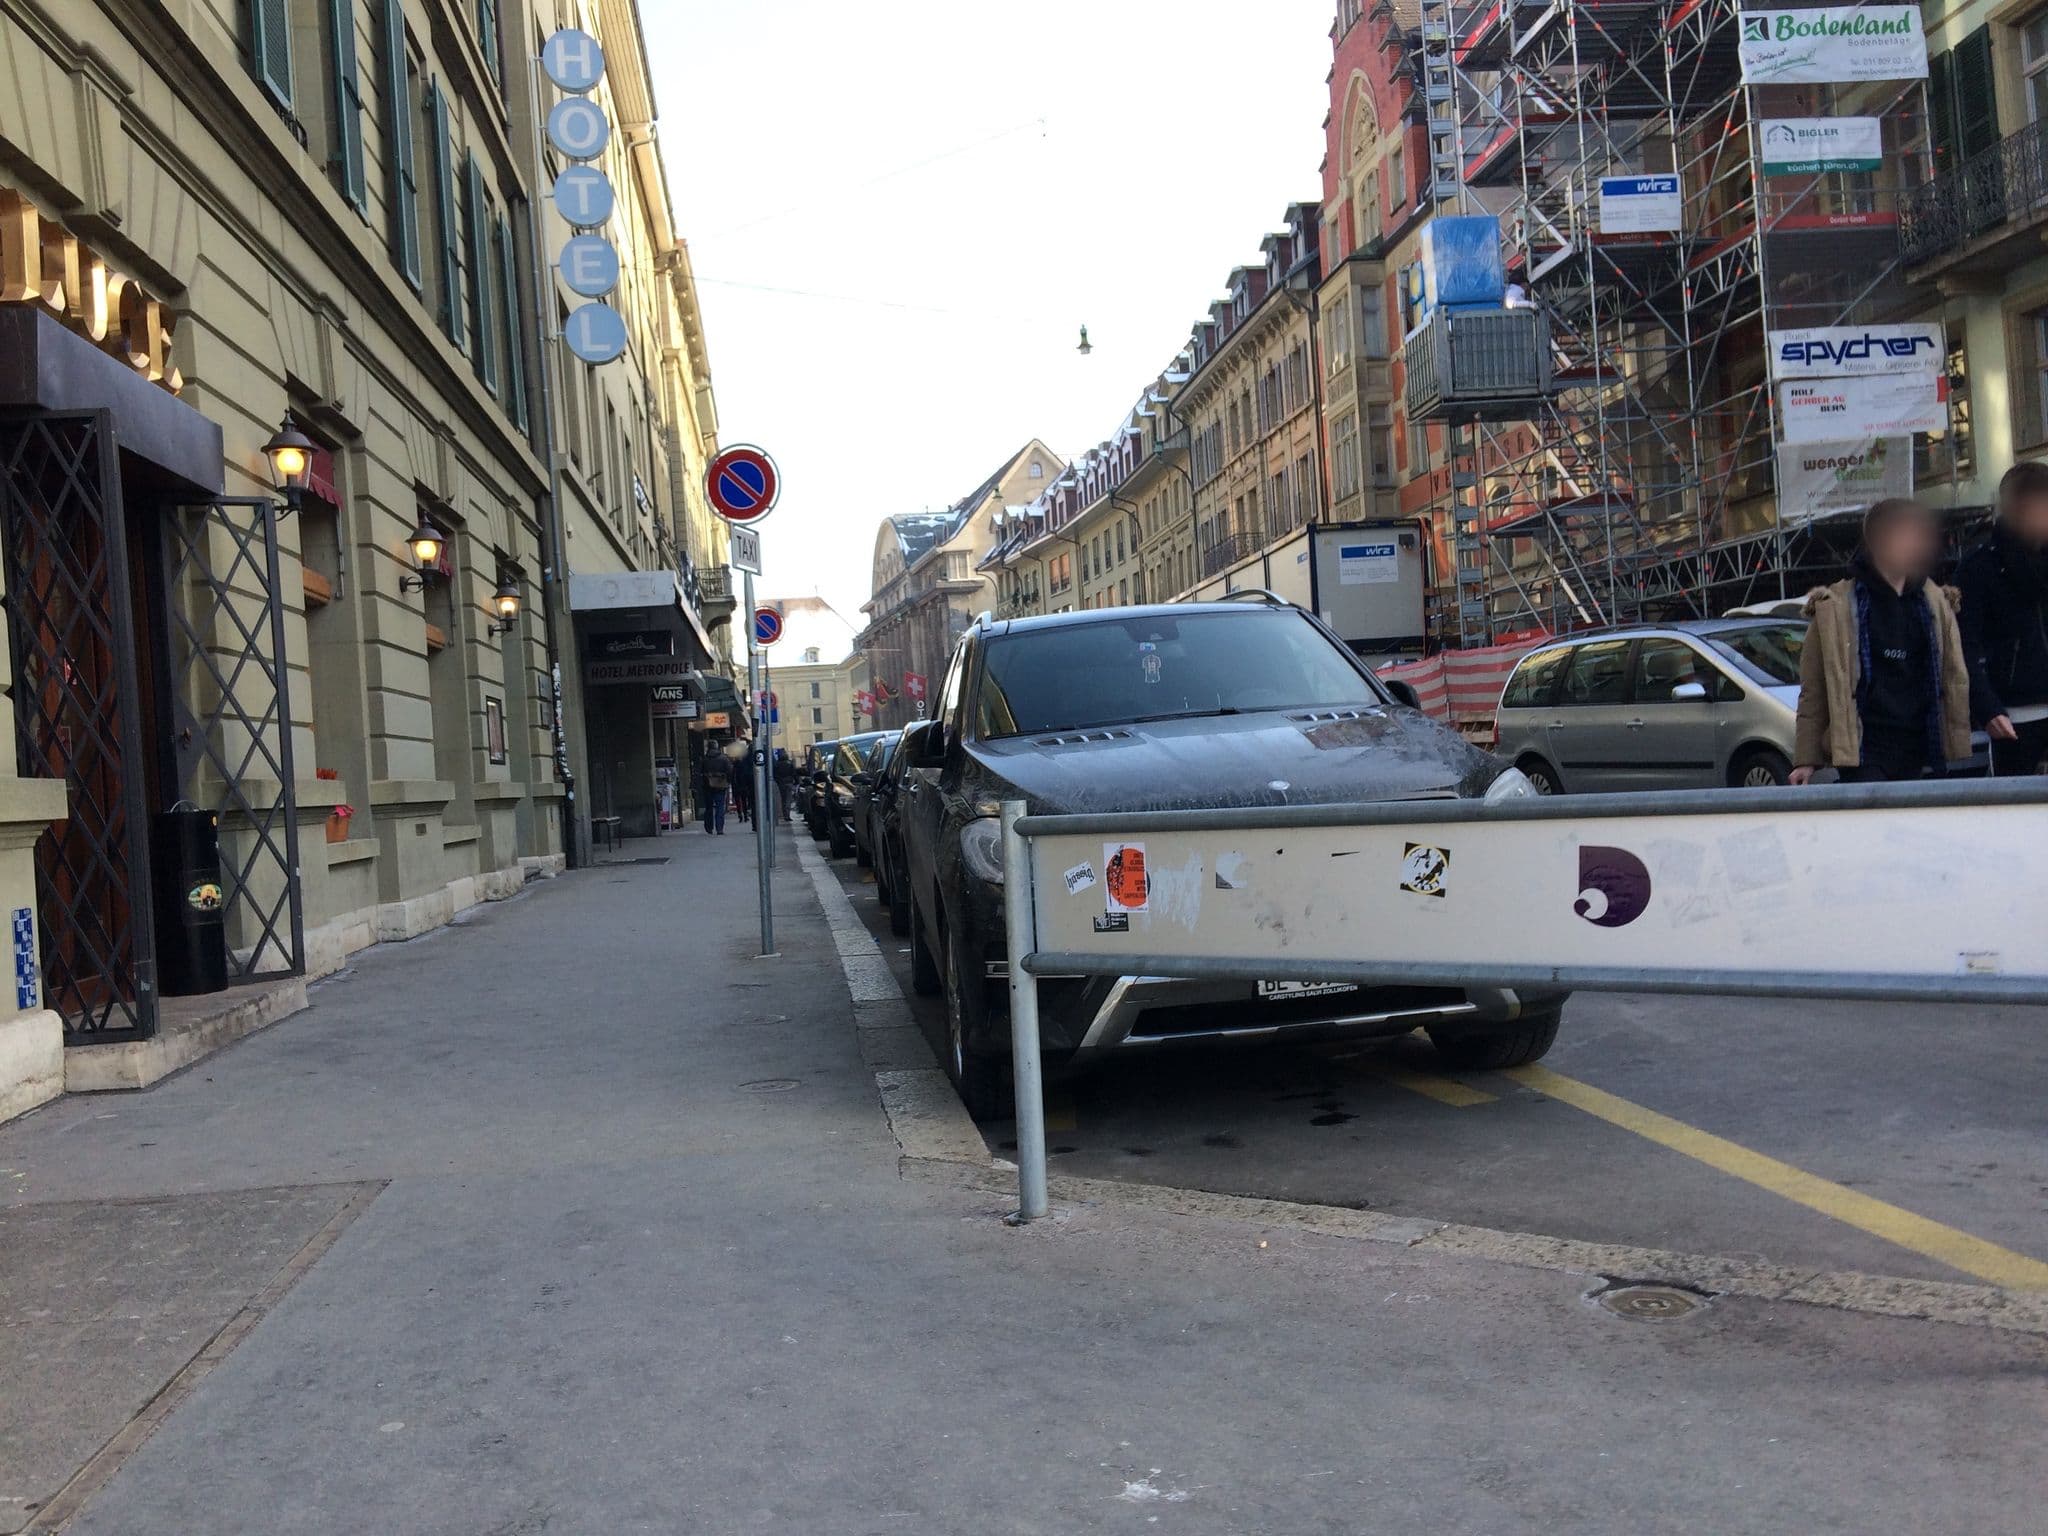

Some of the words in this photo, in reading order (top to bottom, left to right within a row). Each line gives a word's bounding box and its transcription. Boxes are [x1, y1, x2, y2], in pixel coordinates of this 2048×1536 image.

[1775, 10, 1911, 42] Bodenland
[1798, 128, 1839, 138] BIGLER
[1637, 177, 1672, 192] wirz
[555, 38, 611, 352] HOTEL
[1781, 333, 1935, 366] spycher
[1803, 454, 1865, 471] wenger
[737, 534, 757, 563] TAXI
[1365, 545, 1391, 556] wirz
[592, 665, 623, 680] HOTEL
[626, 661, 690, 678] METROPOLE
[653, 686, 683, 700] VANS
